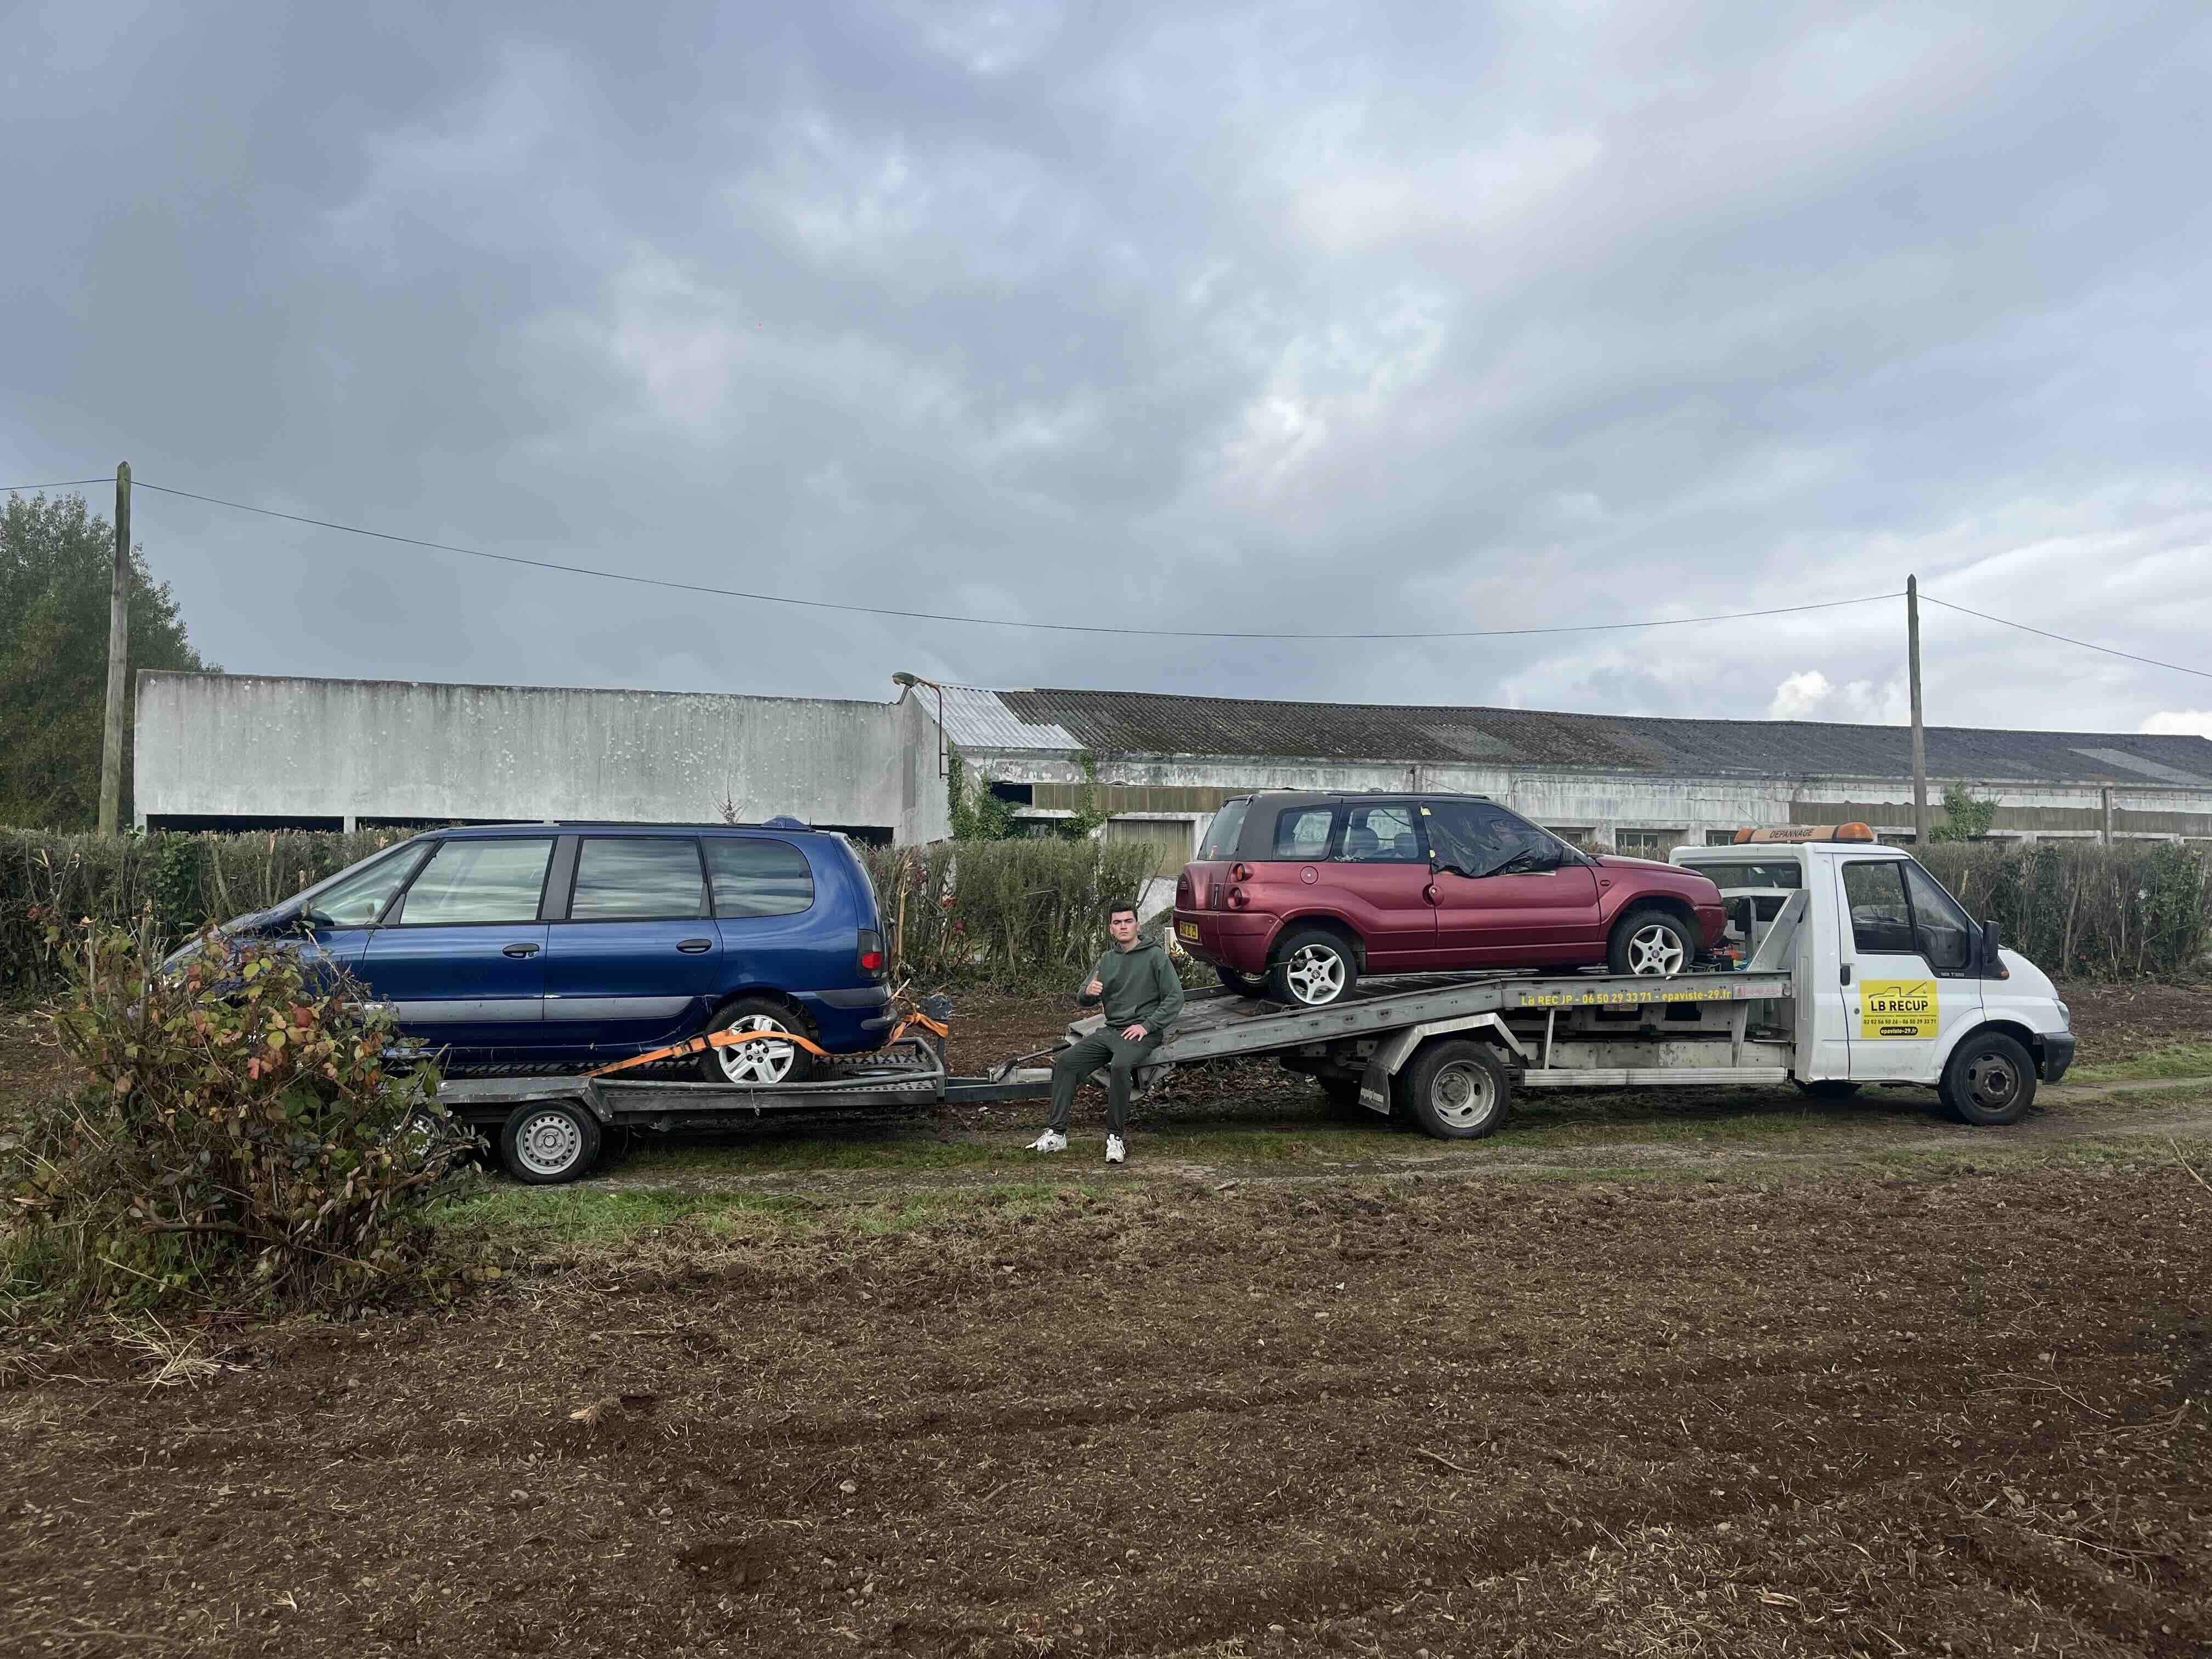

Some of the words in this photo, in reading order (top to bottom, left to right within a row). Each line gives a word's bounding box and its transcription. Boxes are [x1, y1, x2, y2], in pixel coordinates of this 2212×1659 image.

[1582, 994, 1594, 1003] 06
[1597, 994, 1609, 1003] 50
[1612, 992, 1624, 1003] 29
[1627, 992, 1638, 1002] 33
[1640, 992, 1651, 1001] 71
[1662, 989, 1731, 1003] epaviste-29.fr
[1871, 1000, 1886, 1011] LB
[1889, 1000, 1928, 1011] RECUP
